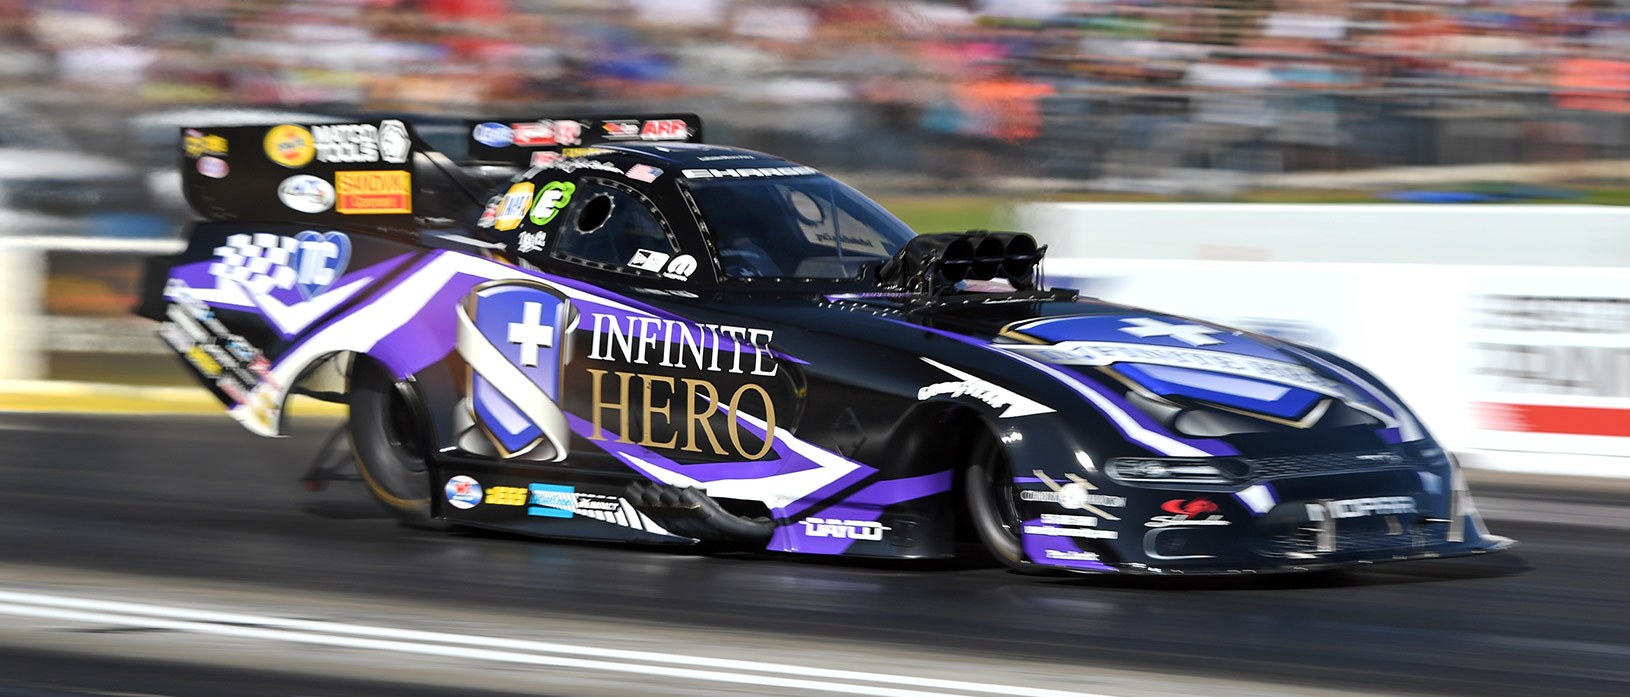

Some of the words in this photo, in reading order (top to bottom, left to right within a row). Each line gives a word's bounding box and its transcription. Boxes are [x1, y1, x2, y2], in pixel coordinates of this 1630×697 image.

[311, 124, 378, 144] MATCO
[641, 120, 687, 137] ARP
[314, 142, 379, 163] TOOLS
[587, 313, 779, 377] INFINITE
[586, 368, 776, 460] HERO
[804, 517, 884, 541] DAYCO
